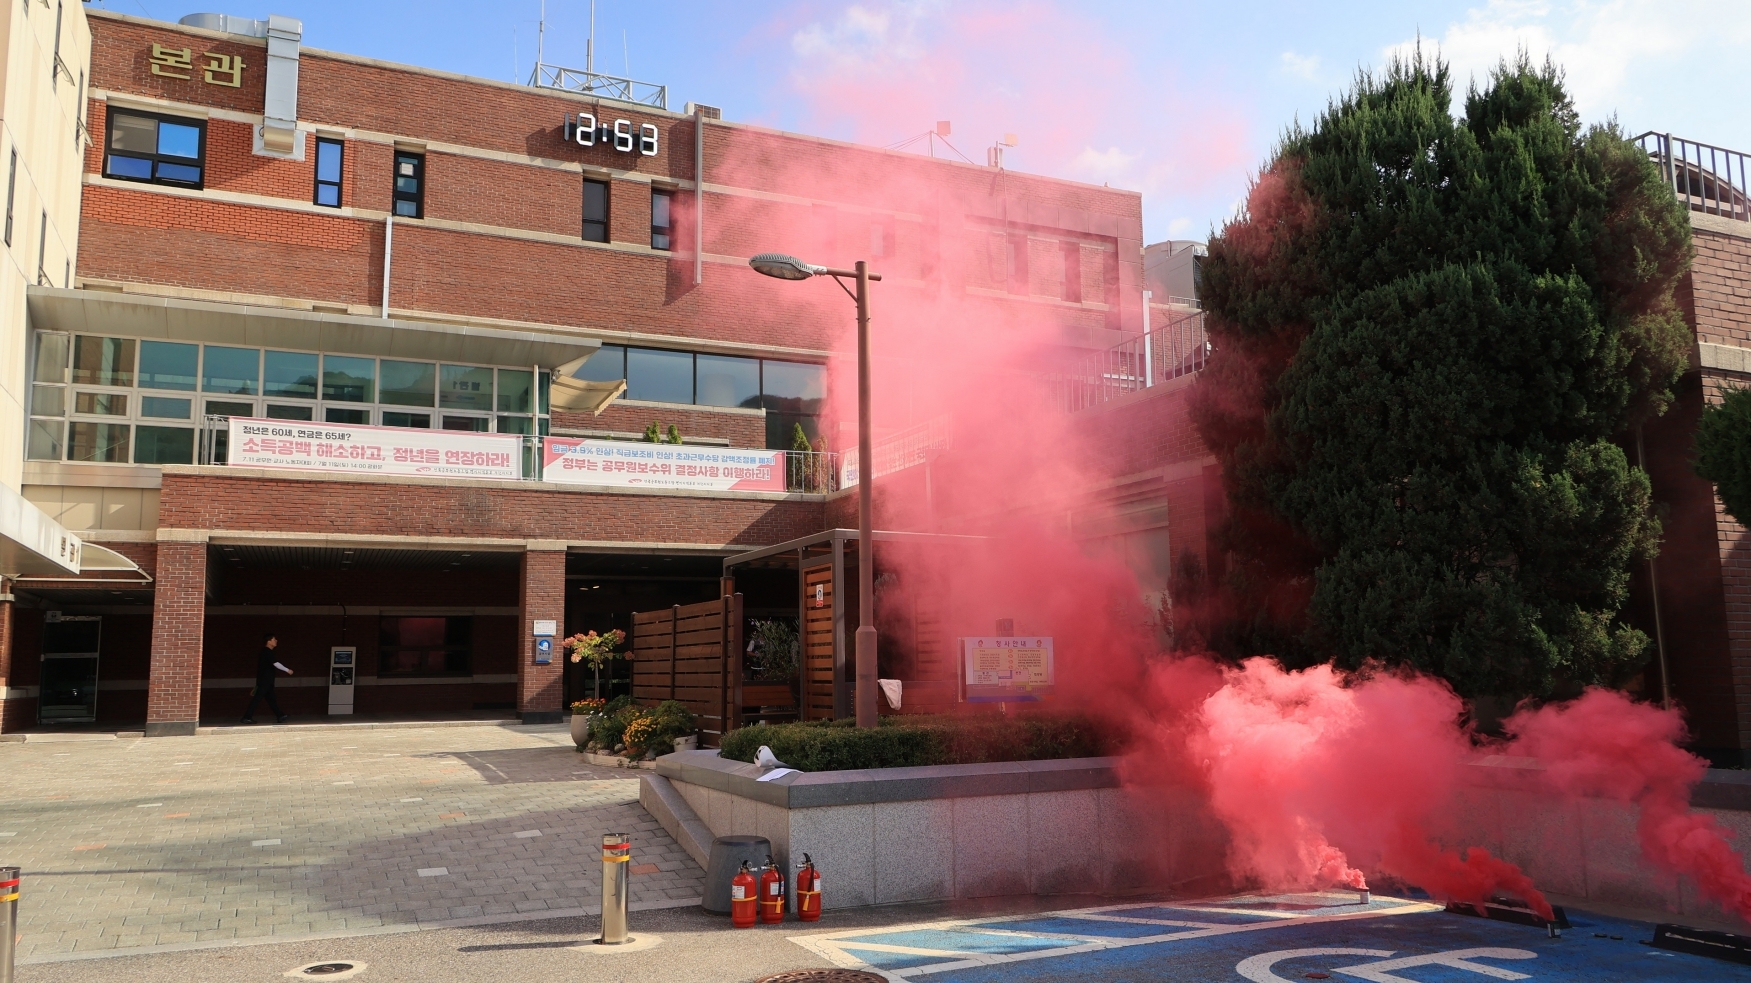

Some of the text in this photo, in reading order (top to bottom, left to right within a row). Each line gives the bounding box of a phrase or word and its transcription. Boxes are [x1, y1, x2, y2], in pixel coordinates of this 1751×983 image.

[149, 41, 246, 88] 본관
[243, 425, 352, 441] 정년은 60세, 연금은 65세?
[242, 437, 510, 468] 소득공백 해소하고, 정년을 연장하라!
[656, 451, 674, 460] 인상!
[675, 452, 719, 463] 초과근무수당
[562, 457, 770, 480] 정부는 공무원보수위 결정사항 이행하라!
